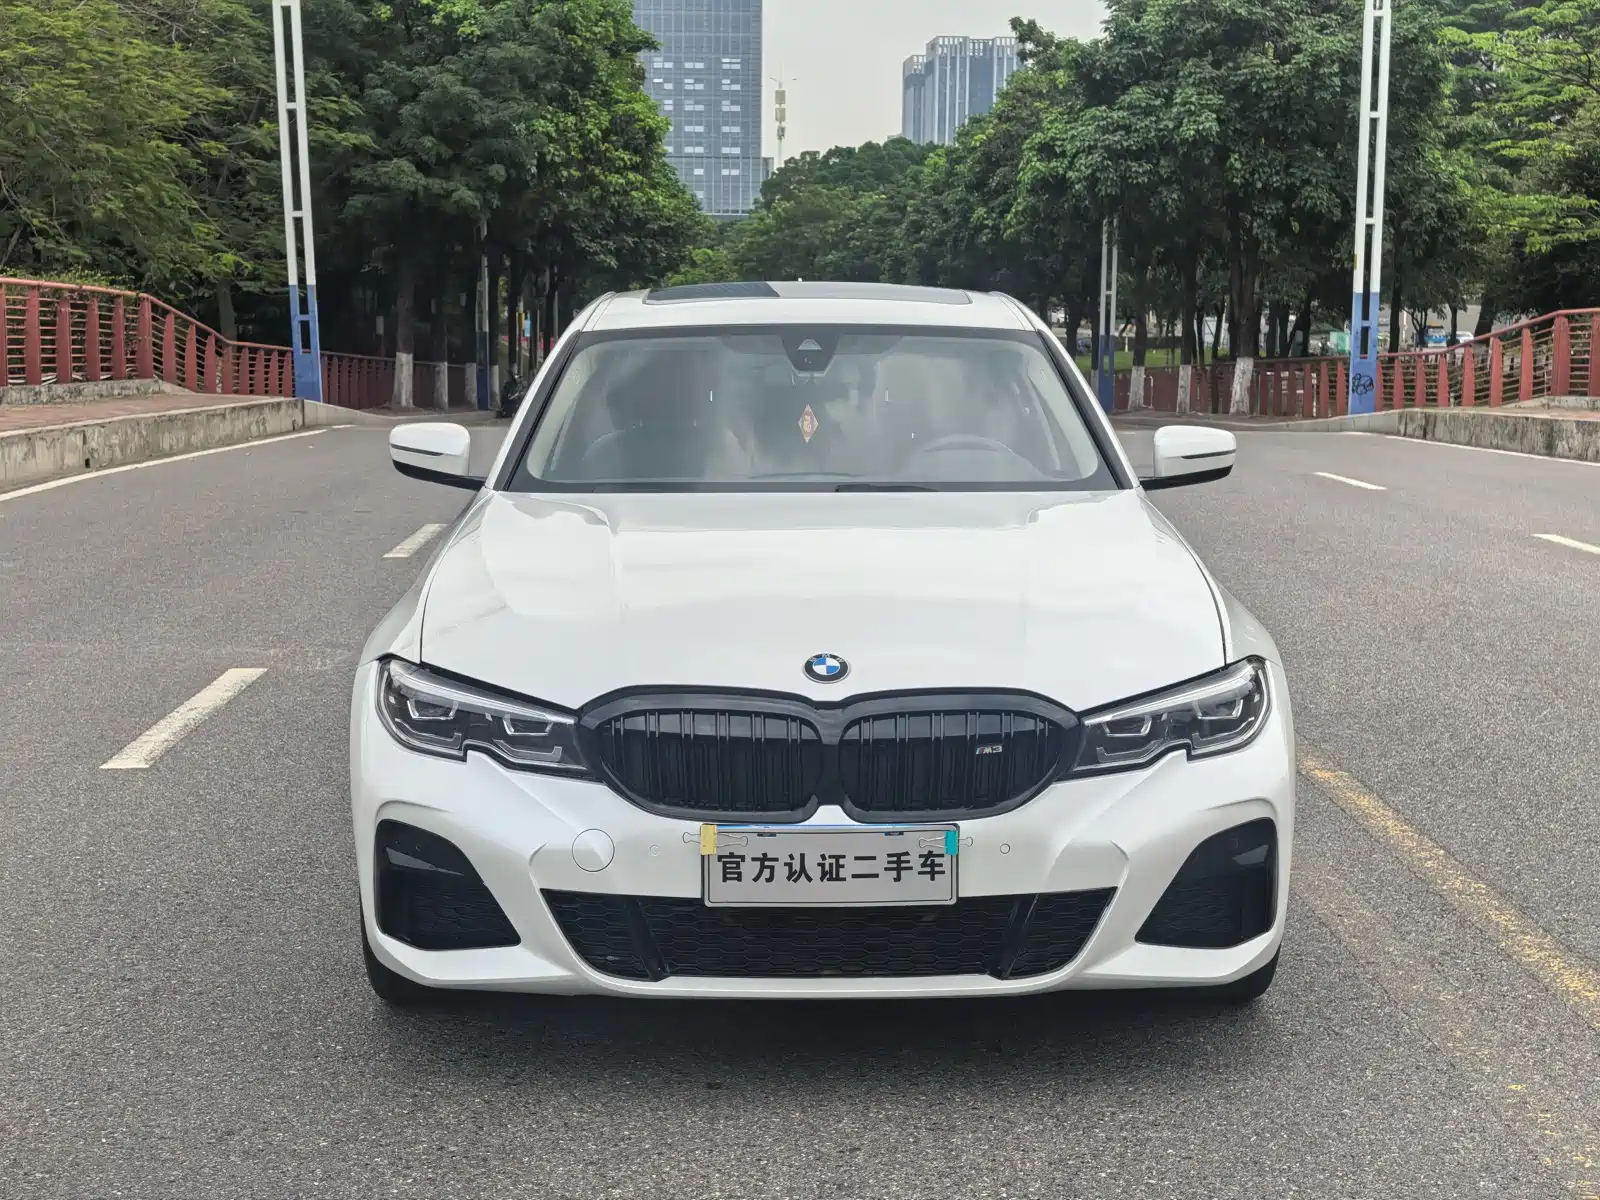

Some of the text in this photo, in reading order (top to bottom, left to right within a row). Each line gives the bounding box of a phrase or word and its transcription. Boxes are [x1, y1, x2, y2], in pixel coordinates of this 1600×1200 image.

[717, 850, 946, 883] 官方认证二手车
